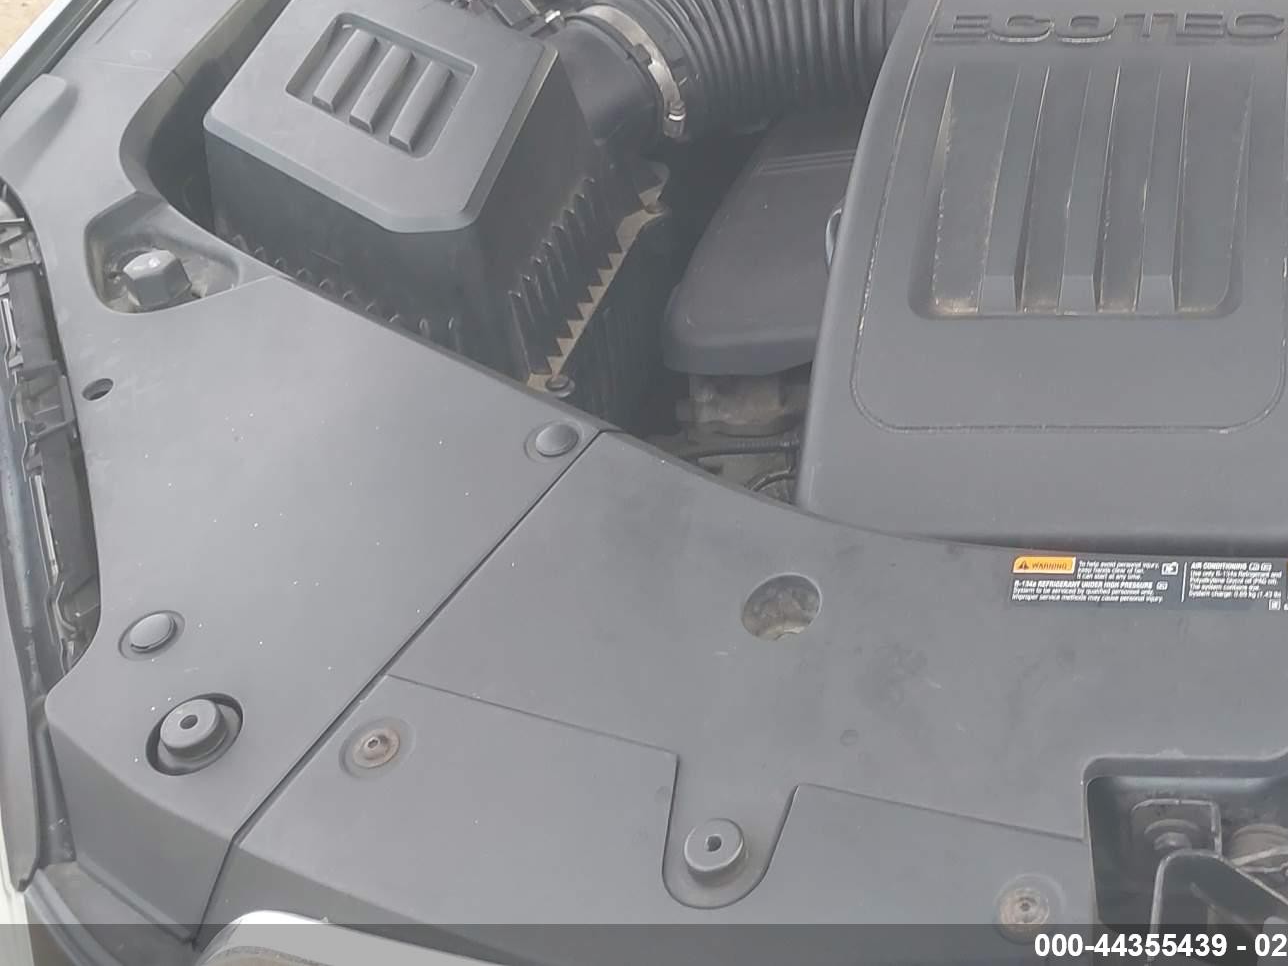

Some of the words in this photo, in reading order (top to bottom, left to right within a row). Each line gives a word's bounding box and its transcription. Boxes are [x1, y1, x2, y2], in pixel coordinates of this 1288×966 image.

[935, 13, 1284, 43] ECOTEC
[1032, 562, 1067, 570] WARNING
[1191, 562, 1202, 570] AIR
